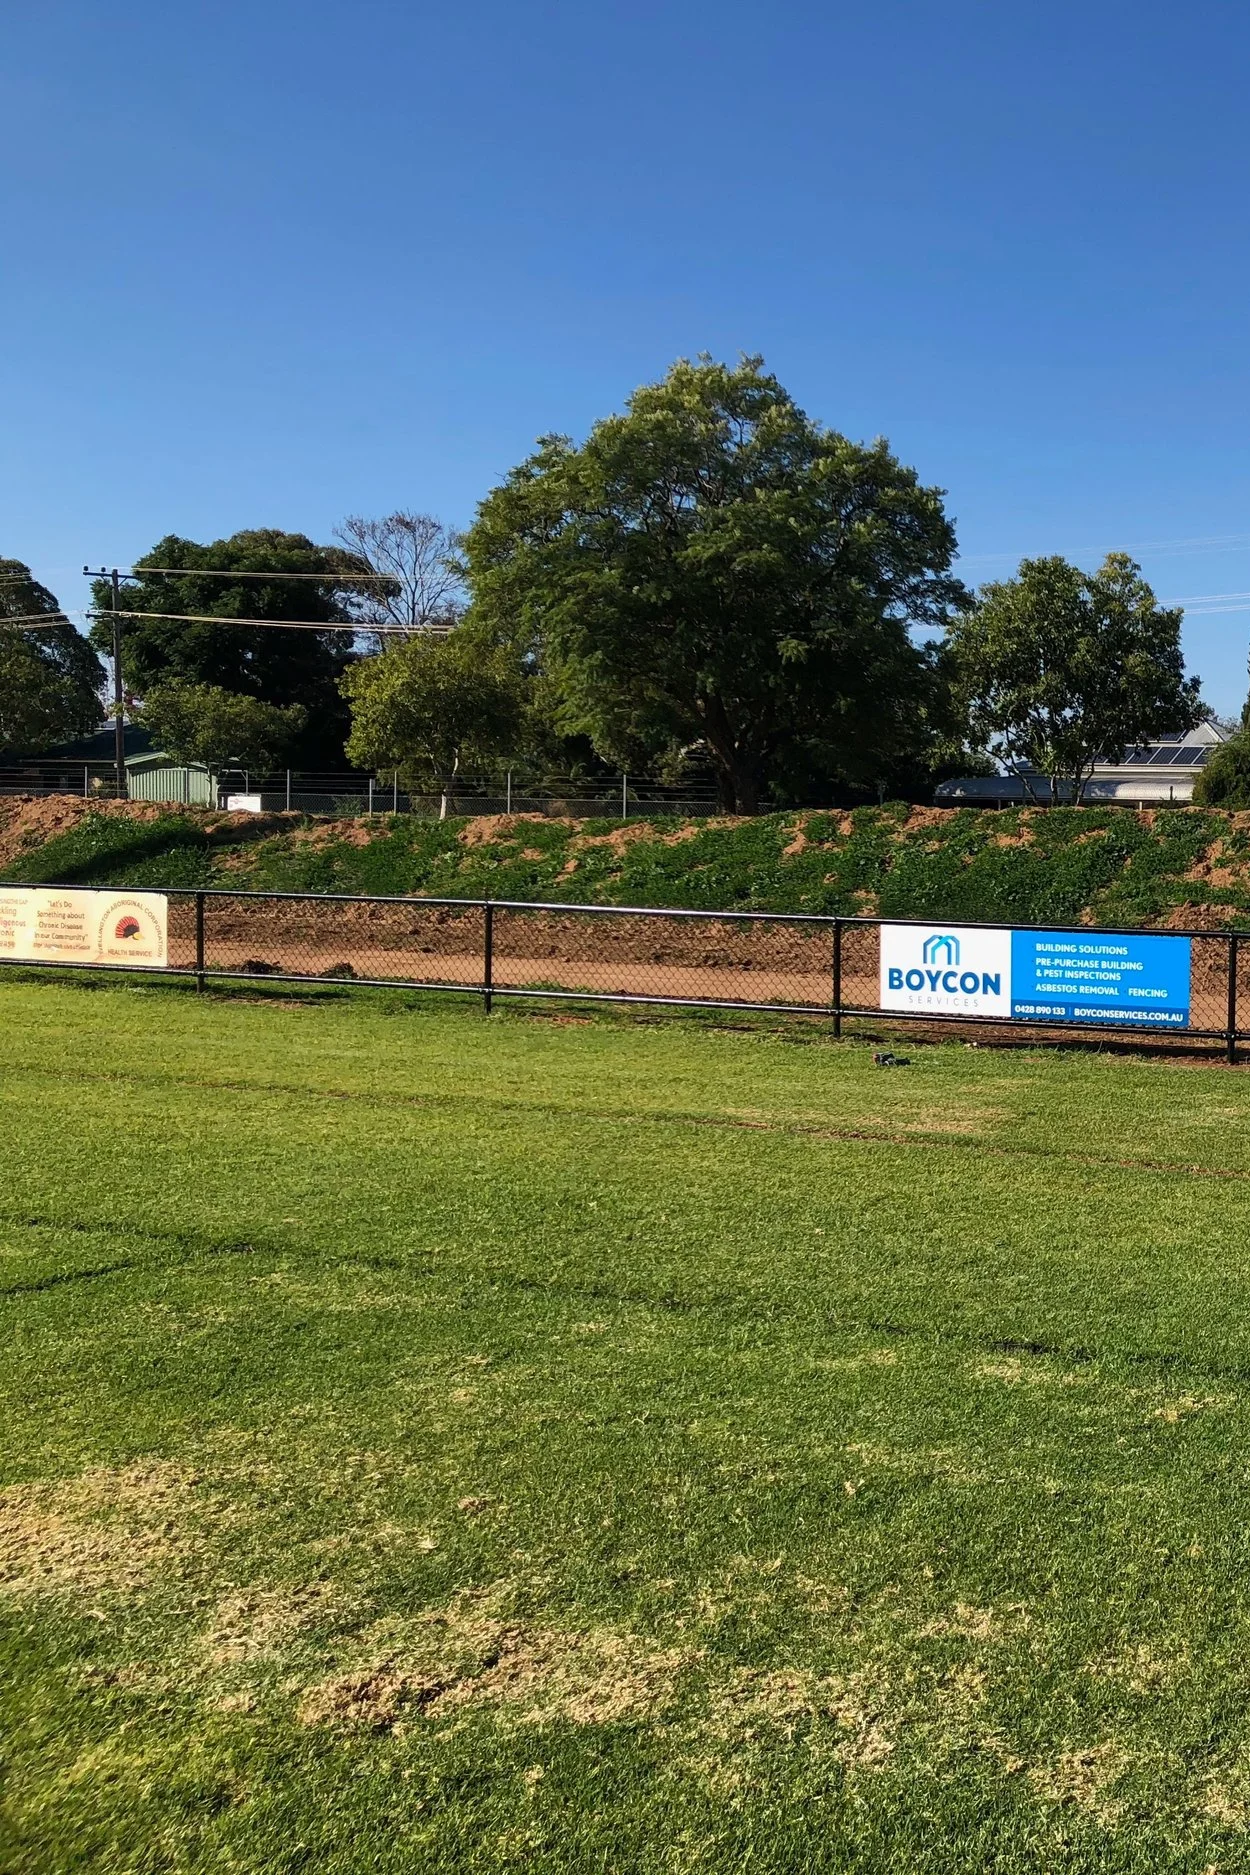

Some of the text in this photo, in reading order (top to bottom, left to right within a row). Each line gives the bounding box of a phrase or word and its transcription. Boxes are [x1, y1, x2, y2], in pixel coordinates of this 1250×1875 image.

[37, 910, 65, 919] Something
[110, 899, 143, 912] ABORIGINAL
[144, 907, 164, 958] CORPORATION
[1036, 943, 1128, 955] BUILDING SOLUTIONS
[1036, 957, 1143, 971] PRE-PURCHASE BUILDING
[888, 967, 1001, 996] BOYCON
[1036, 969, 1121, 981] & PEST INSPECTIONS
[1036, 983, 1168, 998] ASBESTOS REMOVAL FENCING
[908, 995, 980, 1008] SERVICES
[1014, 1004, 1065, 1015] 0428 890 133
[1074, 1007, 1183, 1022] BOYCONSERVICES.COM.AU
